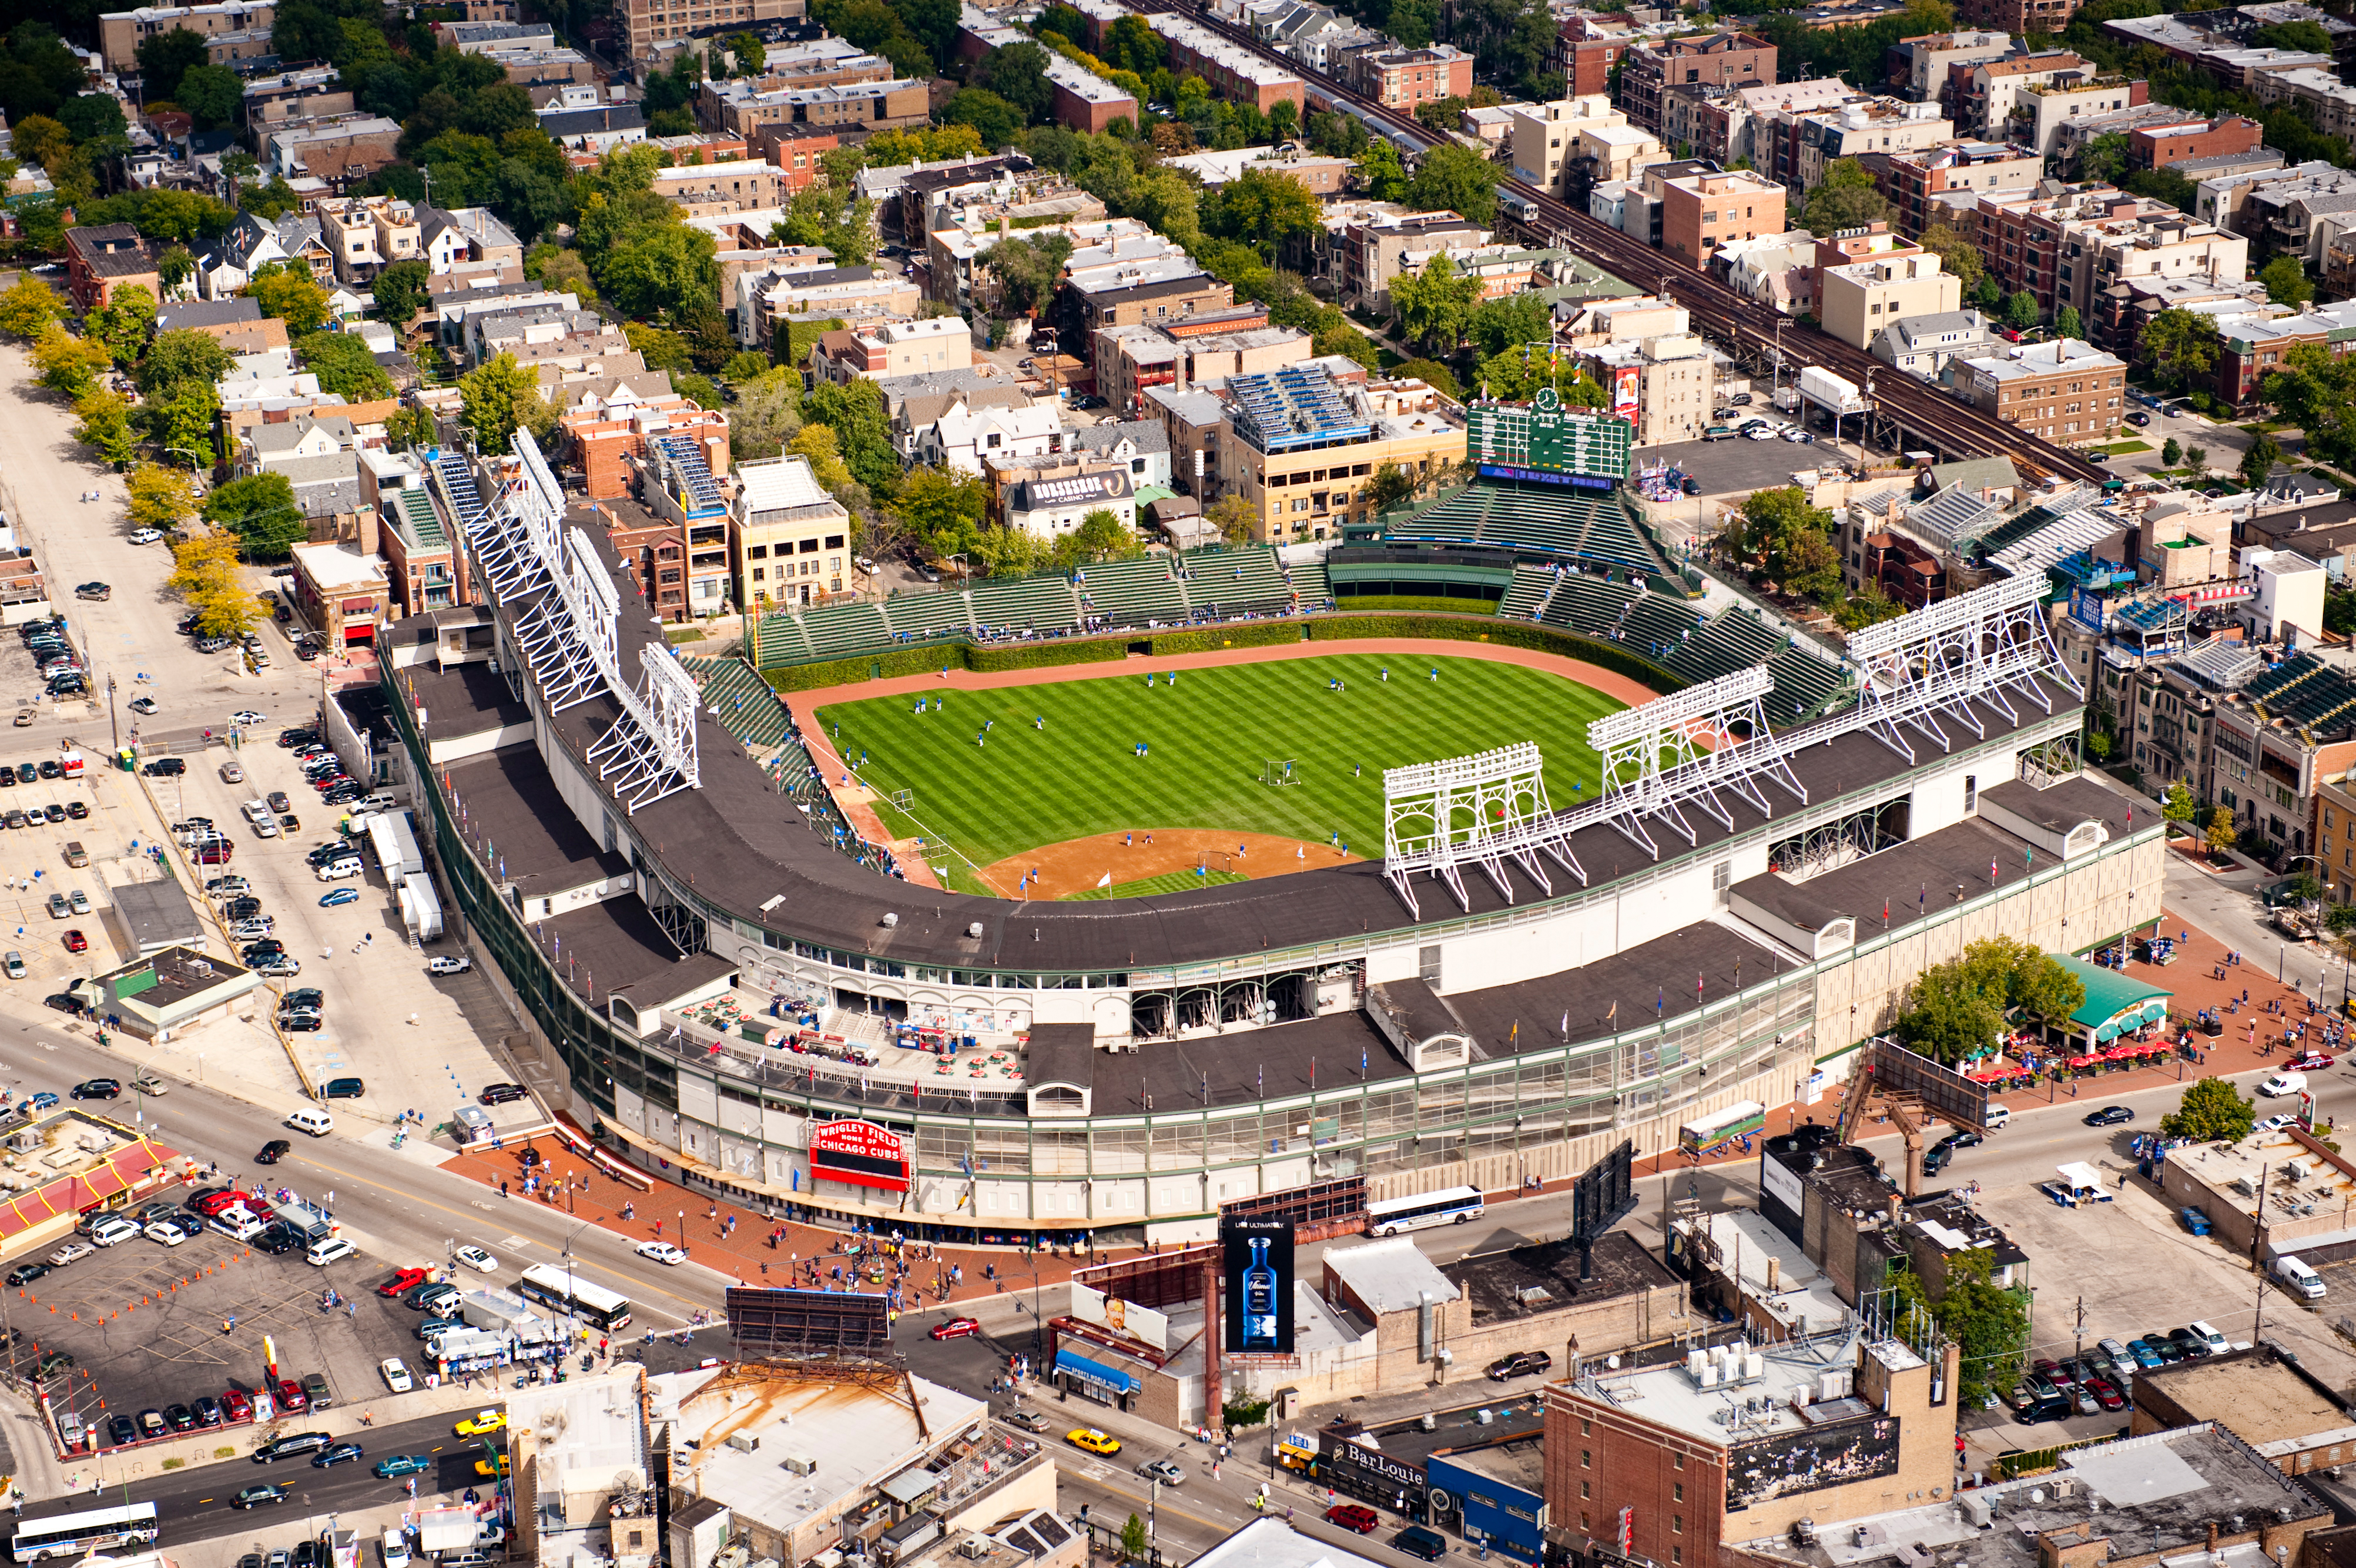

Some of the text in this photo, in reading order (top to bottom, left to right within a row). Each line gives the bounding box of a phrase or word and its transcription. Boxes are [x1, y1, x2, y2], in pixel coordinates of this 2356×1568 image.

[1033, 477, 1103, 499] HORSESHOE
[1058, 494, 1084, 503] CASINO
[2083, 601, 2100, 616] GREAT
[2083, 609, 2099, 625] TASTE
[820, 1123, 898, 1148] WRIGLEY FIELD
[842, 1134, 863, 1143] HOME
[820, 1140, 899, 1160] CHICAGO CUBS
[1125, 1306, 1138, 1315] office
[1072, 1367, 1107, 1385] SPORTS WORLD
[1348, 1444, 1376, 1466] Bar
[1378, 1455, 1423, 1485] Louie
